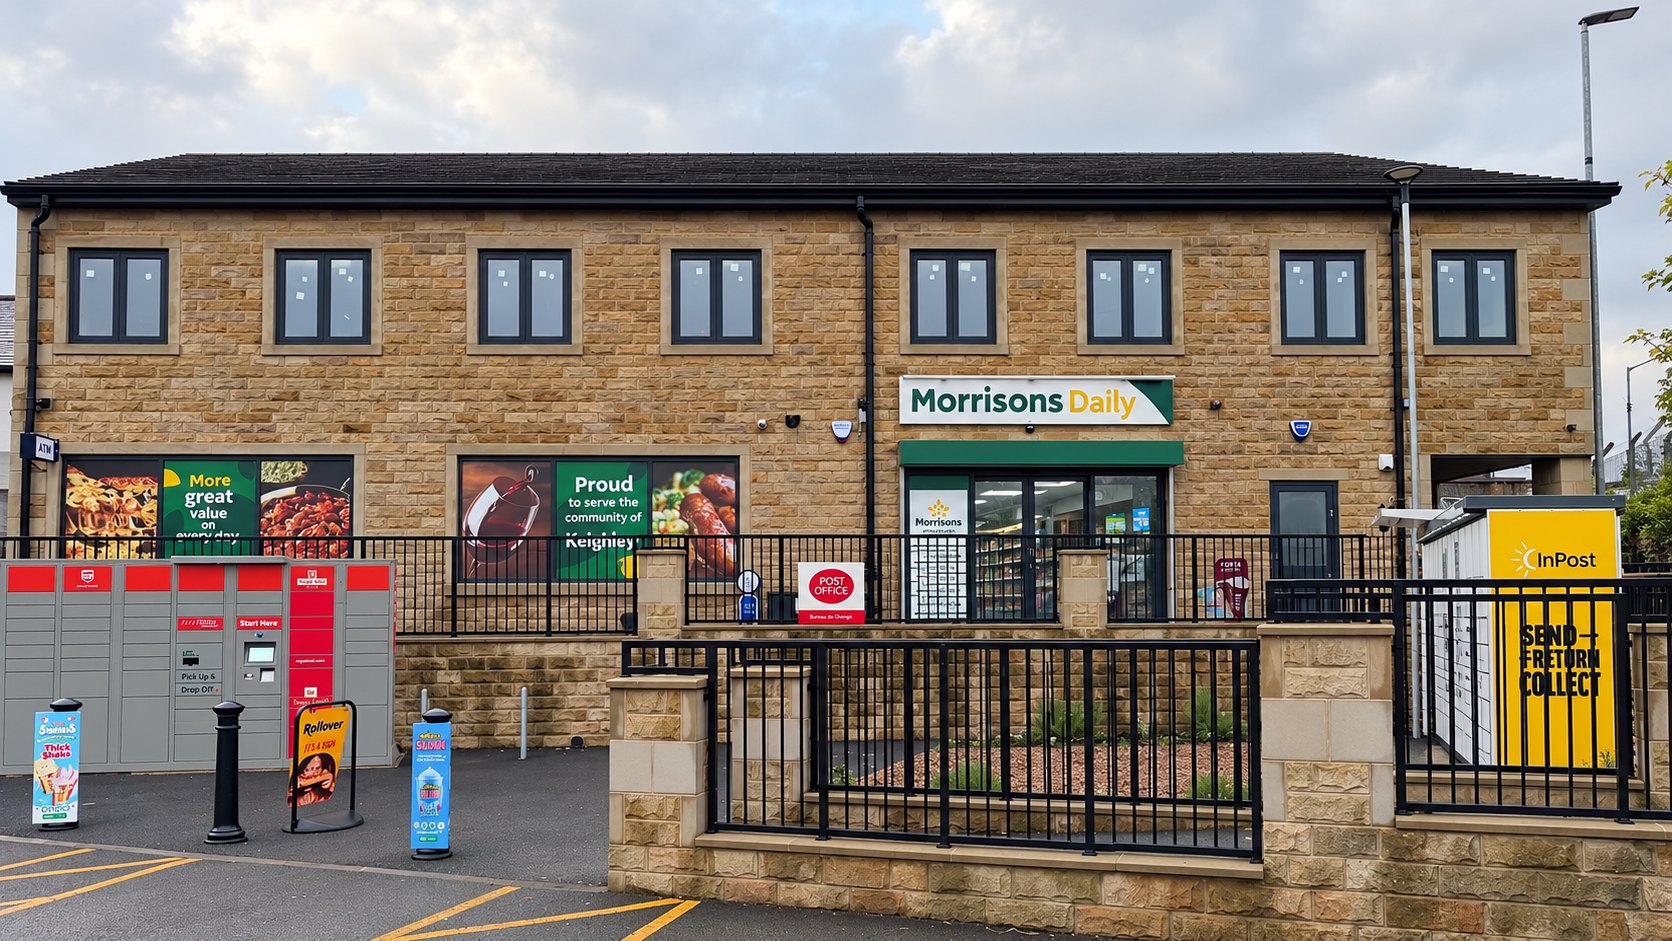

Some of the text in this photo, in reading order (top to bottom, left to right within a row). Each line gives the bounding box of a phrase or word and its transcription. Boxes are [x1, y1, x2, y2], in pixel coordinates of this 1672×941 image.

[911, 385, 1137, 420] Morrisons Daily
[38, 442, 52, 455] ATM
[189, 474, 231, 488] More
[575, 474, 634, 493] Proud
[184, 489, 234, 508] great
[568, 496, 639, 508] to serve the
[189, 506, 228, 519] value
[564, 511, 643, 525] community of
[201, 521, 216, 530] on
[915, 517, 963, 527] Morrisons
[1537, 552, 1597, 568] InPost
[819, 576, 845, 586] POST
[814, 586, 848, 595] OFFICE
[239, 619, 278, 627] Start Here
[1520, 624, 1577, 647] SEND
[198, 673, 209, 681] Up
[181, 686, 200, 695] Drop
[1519, 671, 1601, 697] COLLECT
[303, 720, 345, 737] Rollover
[44, 743, 71, 752] Thick
